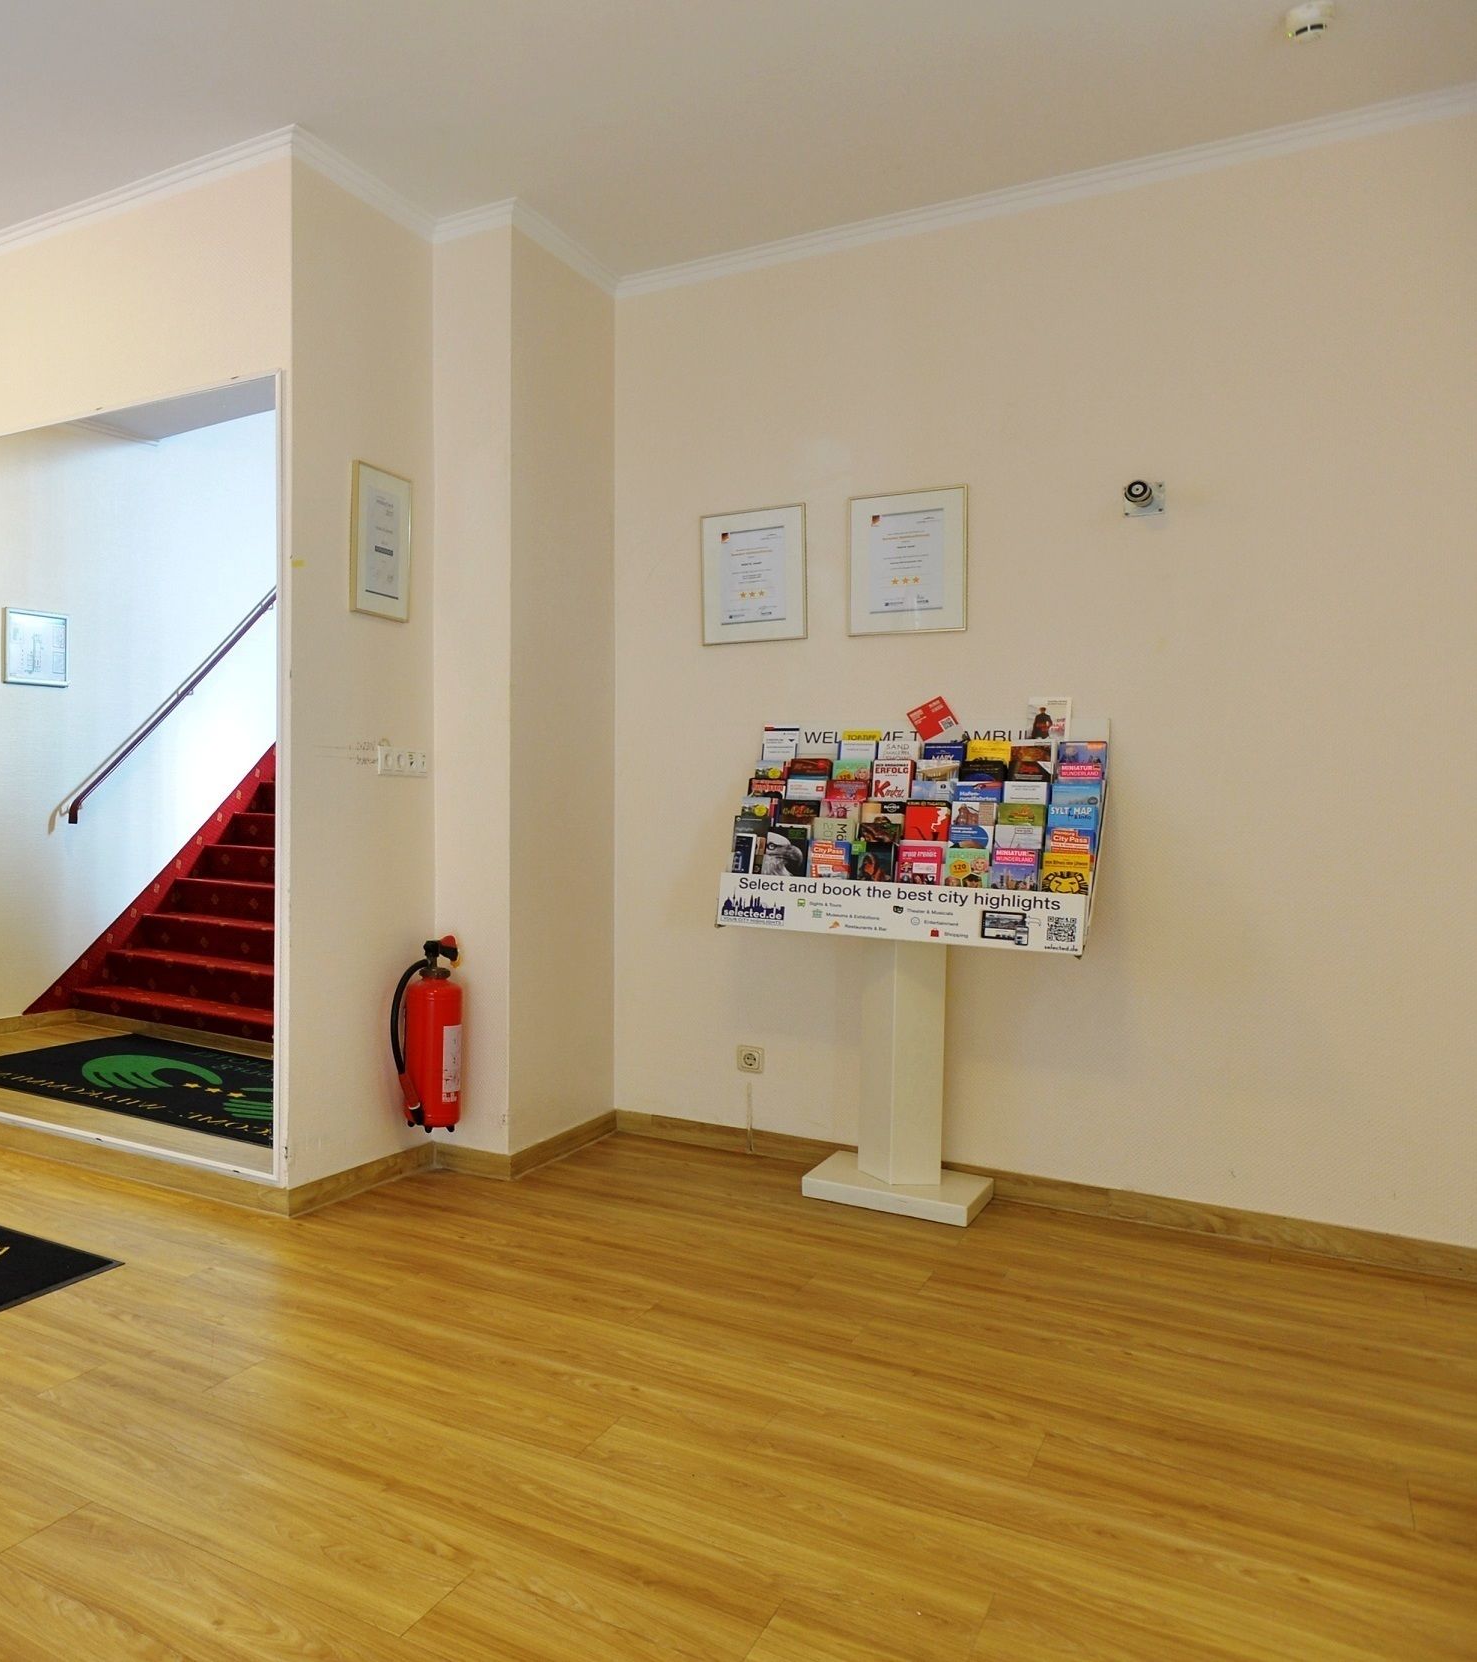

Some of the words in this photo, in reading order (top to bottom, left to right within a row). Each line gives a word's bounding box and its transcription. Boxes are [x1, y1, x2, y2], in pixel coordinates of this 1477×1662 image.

[875, 767, 909, 775] ERFOLG
[1050, 807, 1070, 815] SYLT
[1073, 807, 1092, 815] MAP
[1053, 835, 1069, 843] City
[996, 849, 1027, 857] MINIATUR
[738, 878, 785, 892] Select
[788, 881, 817, 894] and
[822, 882, 861, 897] book
[866, 886, 892, 899] the
[897, 888, 933, 901] best
[938, 891, 969, 907] city
[974, 893, 1061, 911] highlights
[723, 907, 783, 920] selected.de
